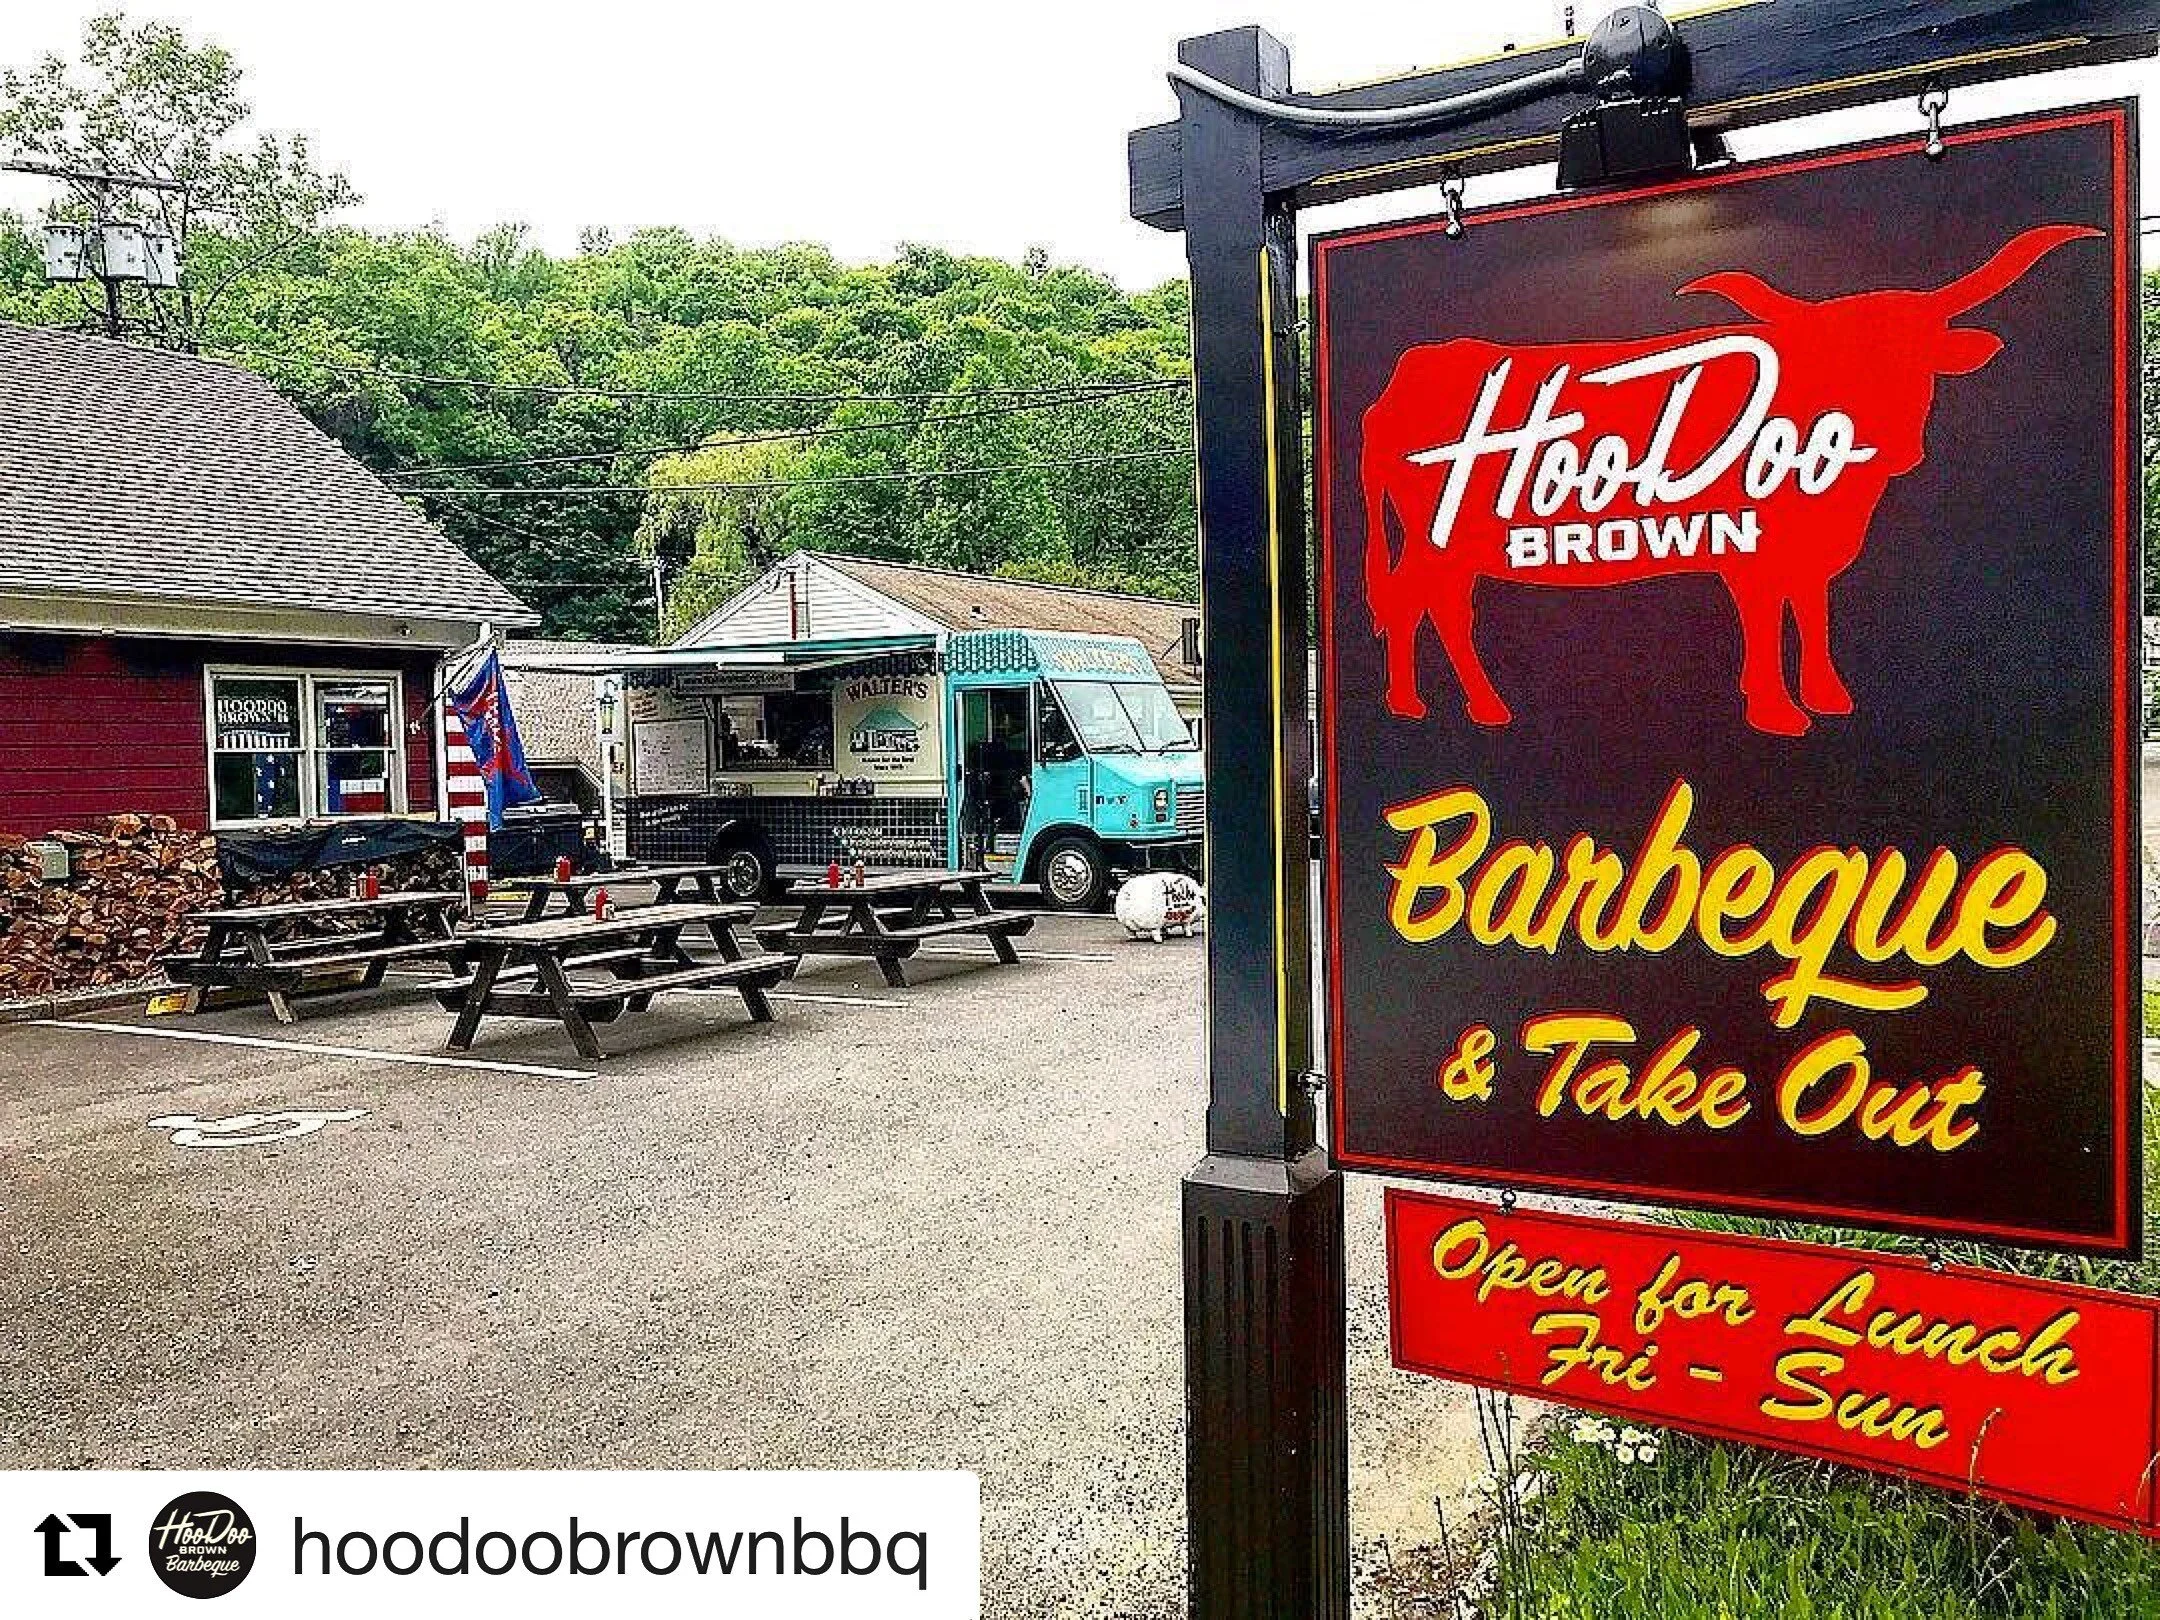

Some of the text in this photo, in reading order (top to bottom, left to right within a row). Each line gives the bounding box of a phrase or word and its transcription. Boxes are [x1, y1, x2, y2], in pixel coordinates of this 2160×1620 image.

[1406, 334, 1878, 549] HooDoo
[1505, 508, 1762, 569] BROWN
[847, 679, 928, 701] WALTER'S
[1382, 778, 2056, 1028] Barbeque
[1437, 1012, 1984, 1152] & Take Out
[1432, 1218, 2082, 1386] Open for Lunch
[1531, 1312, 1950, 1450] Fri - Sun
